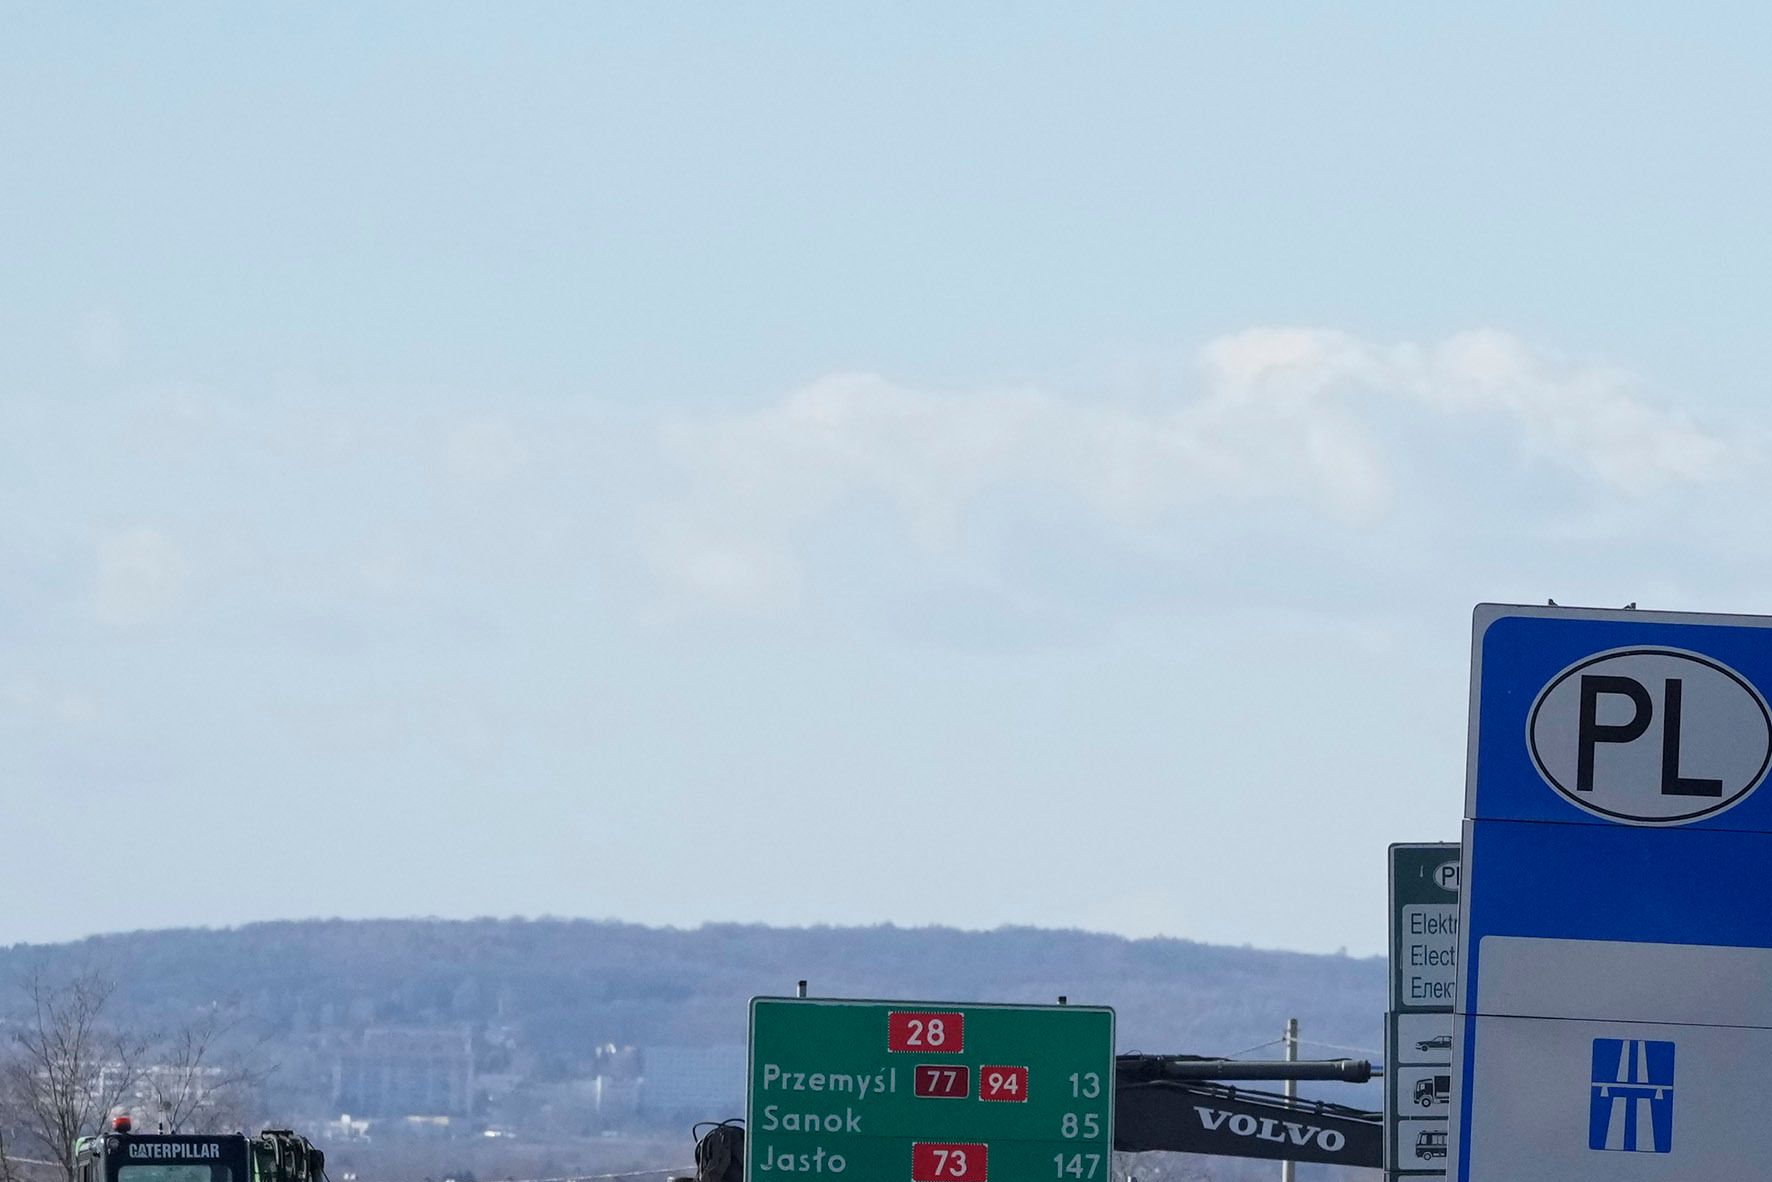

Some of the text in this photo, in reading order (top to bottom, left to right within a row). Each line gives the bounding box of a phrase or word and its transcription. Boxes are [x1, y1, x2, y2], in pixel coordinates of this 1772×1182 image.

[1575, 673, 1724, 798] PL
[905, 1018, 946, 1047] 28
[762, 1063, 1100, 1100] Przemyśl 77 94 13
[761, 1104, 1100, 1140] Sanok 85
[1192, 1105, 1346, 1152] VOLVO
[128, 1143, 221, 1158] CATERPILLAR
[759, 1145, 1101, 1180] Jasło 73 147
